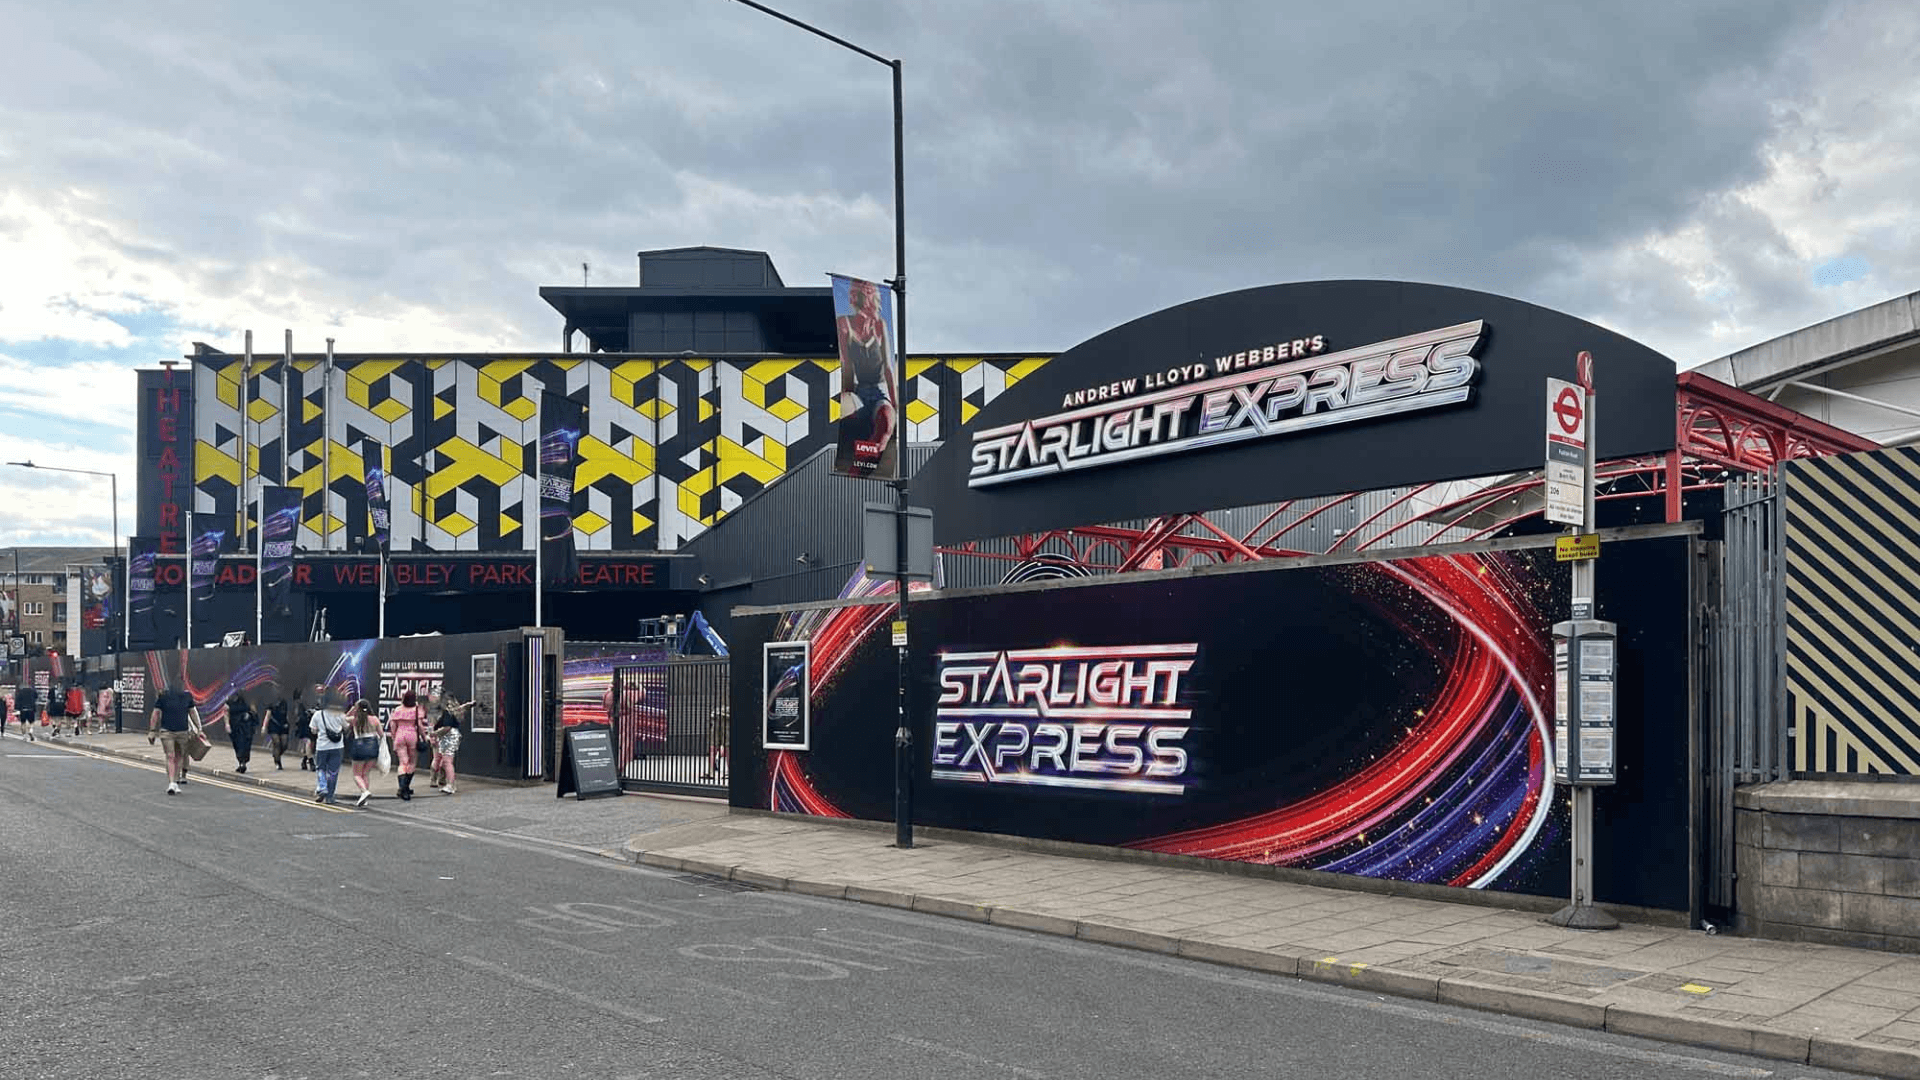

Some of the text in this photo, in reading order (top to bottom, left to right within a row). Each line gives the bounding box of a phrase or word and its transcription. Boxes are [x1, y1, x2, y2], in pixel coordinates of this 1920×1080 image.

[1062, 335, 1324, 409] ANDREW LLOYD WEBBER'S
[1584, 357, 1593, 383] K
[970, 335, 1479, 476] STARLIGHT EXPRESS
[1550, 486, 1560, 497] 206
[470, 563, 533, 585] PARK
[557, 563, 654, 585] EATRE
[938, 652, 1196, 714] STARLIGHT
[933, 722, 1190, 779] EXPRESS
